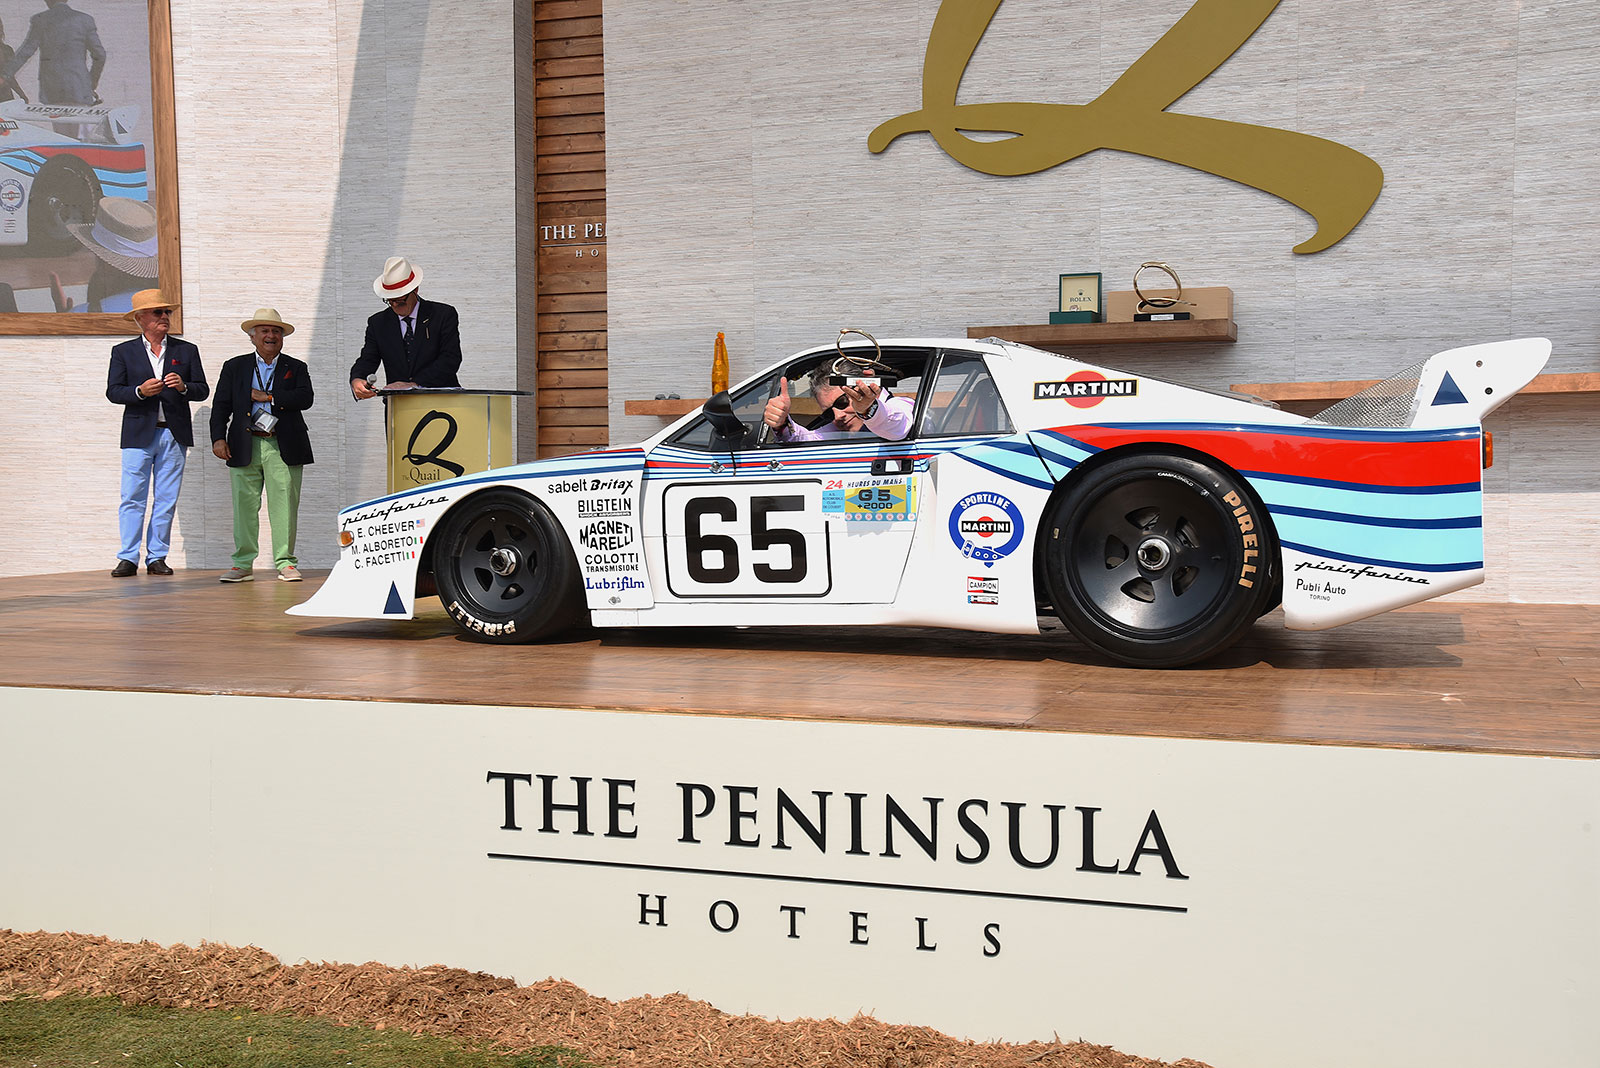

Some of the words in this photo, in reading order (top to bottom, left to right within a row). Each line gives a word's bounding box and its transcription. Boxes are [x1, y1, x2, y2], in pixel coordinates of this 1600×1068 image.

[541, 224, 576, 240] THE
[584, 223, 607, 238] PE
[1038, 381, 1132, 397] MARTINI
[409, 467, 440, 484] Quail
[825, 479, 844, 490] 24
[871, 479, 882, 487] DU
[882, 477, 903, 486] MANS
[547, 479, 588, 494] sabelt
[590, 479, 634, 495] Britax
[578, 498, 632, 512] BILSTEIN
[959, 494, 1011, 510] SPORTLINE
[342, 496, 449, 531] pininfarina
[357, 527, 366, 538] E.
[368, 520, 415, 537] CHEEVER
[579, 520, 634, 543] MAGNETI
[963, 522, 1009, 531] MARTINI
[351, 545, 361, 556] M.
[363, 536, 414, 554] ALBORETO
[579, 531, 634, 551] MARELLI
[684, 494, 808, 584] 65
[1222, 490, 1259, 589] PIRELLI
[354, 559, 364, 569] C.
[366, 551, 406, 567] FACETTI
[584, 552, 639, 565] COLOTTI
[1294, 561, 1430, 585] pininfarina
[585, 576, 645, 591] Lubrifilm
[1296, 578, 1321, 593] Publi
[1323, 582, 1347, 595] Auto
[449, 600, 516, 637] PIRELLI
[486, 770, 639, 839] THE
[676, 782, 1190, 880] PENINSULA
[637, 892, 1002, 958] HOTELS
